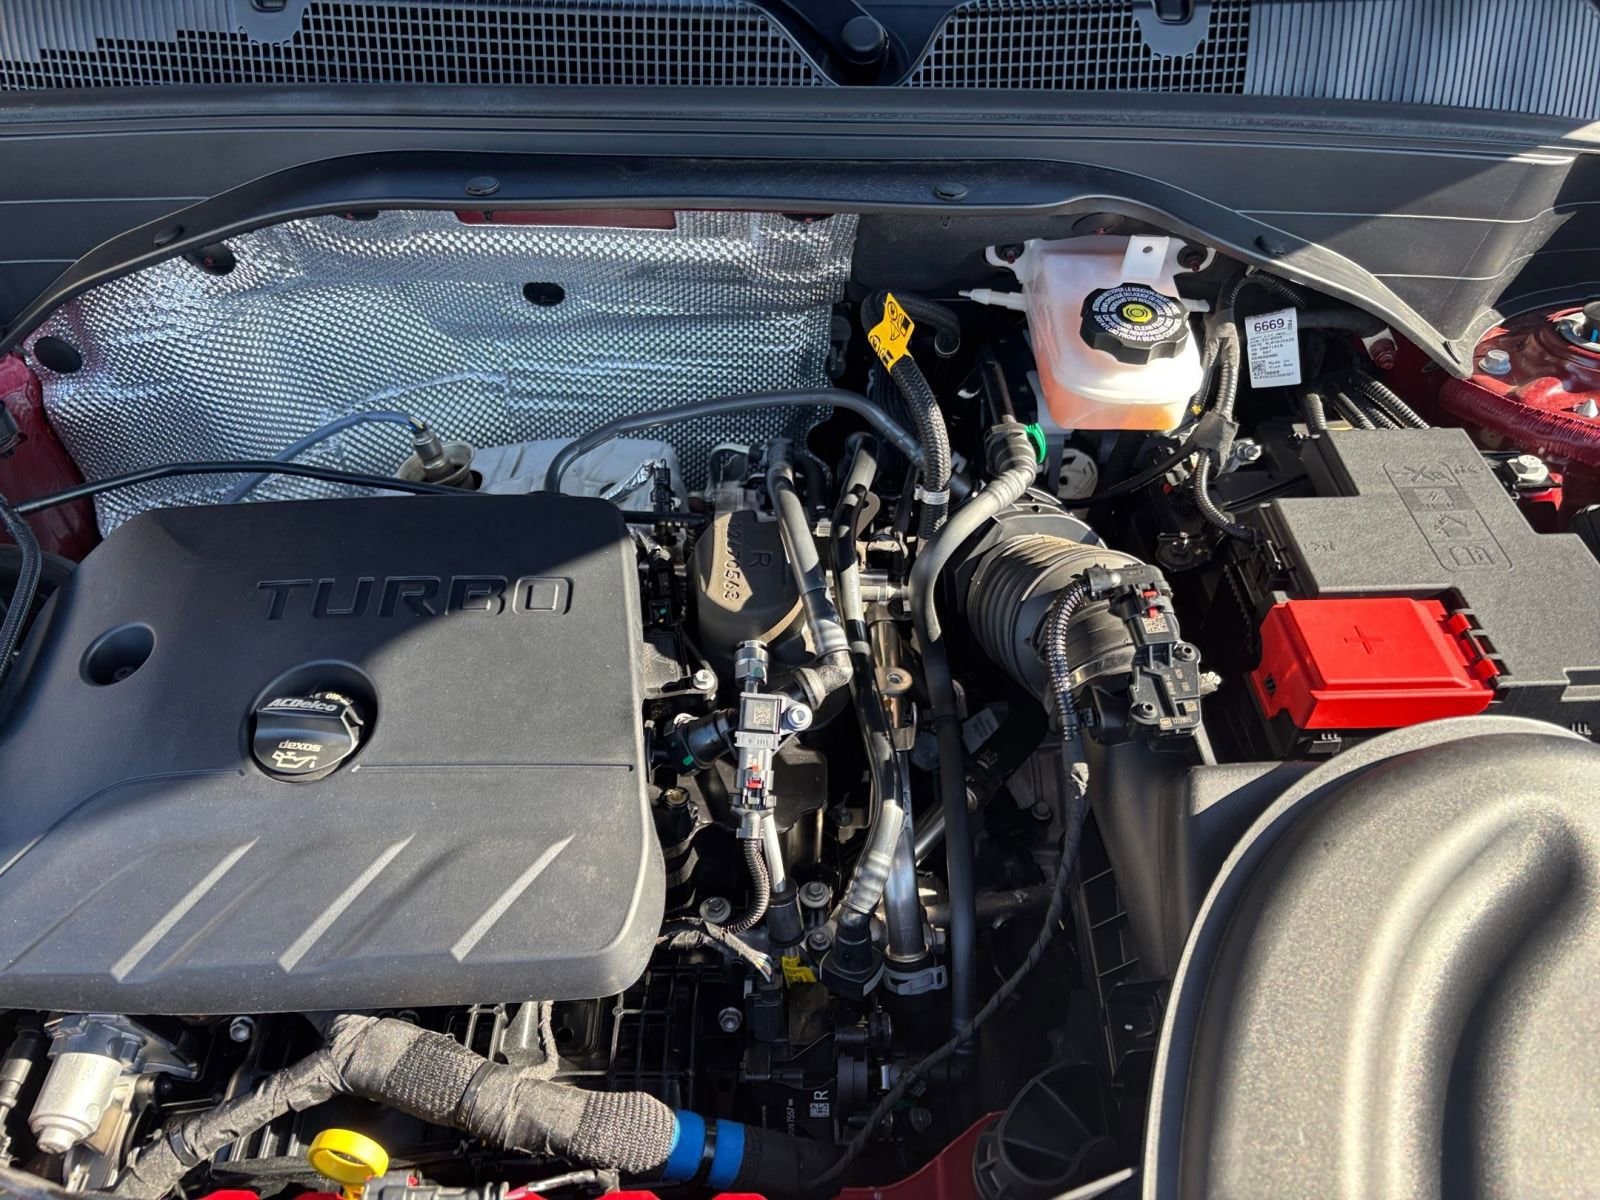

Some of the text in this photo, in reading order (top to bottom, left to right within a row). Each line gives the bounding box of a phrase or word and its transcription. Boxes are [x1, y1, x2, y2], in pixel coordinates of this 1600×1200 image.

[1254, 319, 1284, 332] 6669
[750, 552, 772, 568] R
[256, 575, 574, 621] TURBO
[267, 698, 338, 712] ACDelco
[278, 740, 323, 752] dexos
[814, 1090, 829, 1100] R
